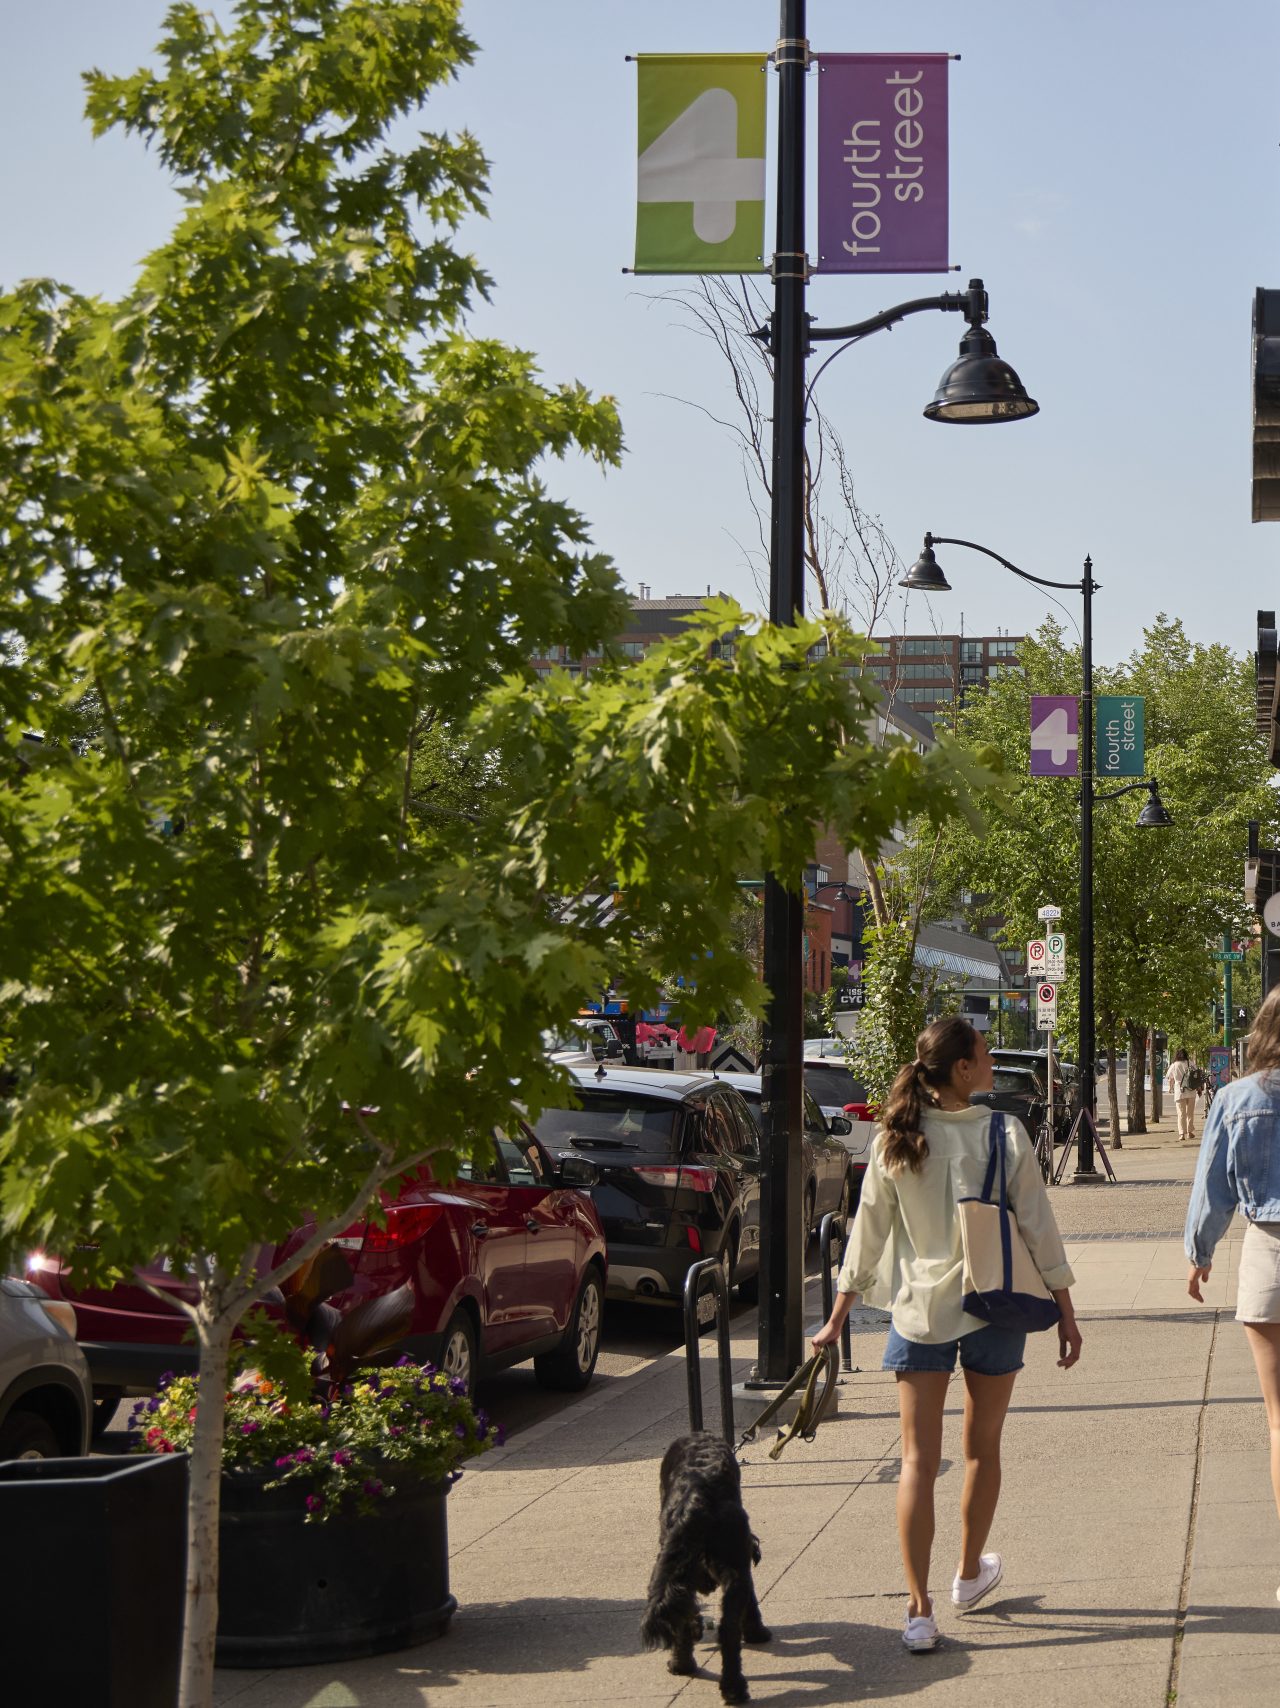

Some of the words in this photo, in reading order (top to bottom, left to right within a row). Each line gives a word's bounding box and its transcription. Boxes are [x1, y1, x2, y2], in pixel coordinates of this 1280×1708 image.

[886, 70, 924, 203] street
[638, 88, 765, 244] 4
[843, 120, 881, 256] fourth
[1031, 708, 1078, 766] 4
[1106, 719, 1120, 771] fourth
[1121, 702, 1135, 751] street
[1041, 909, 1057, 917] 4822
